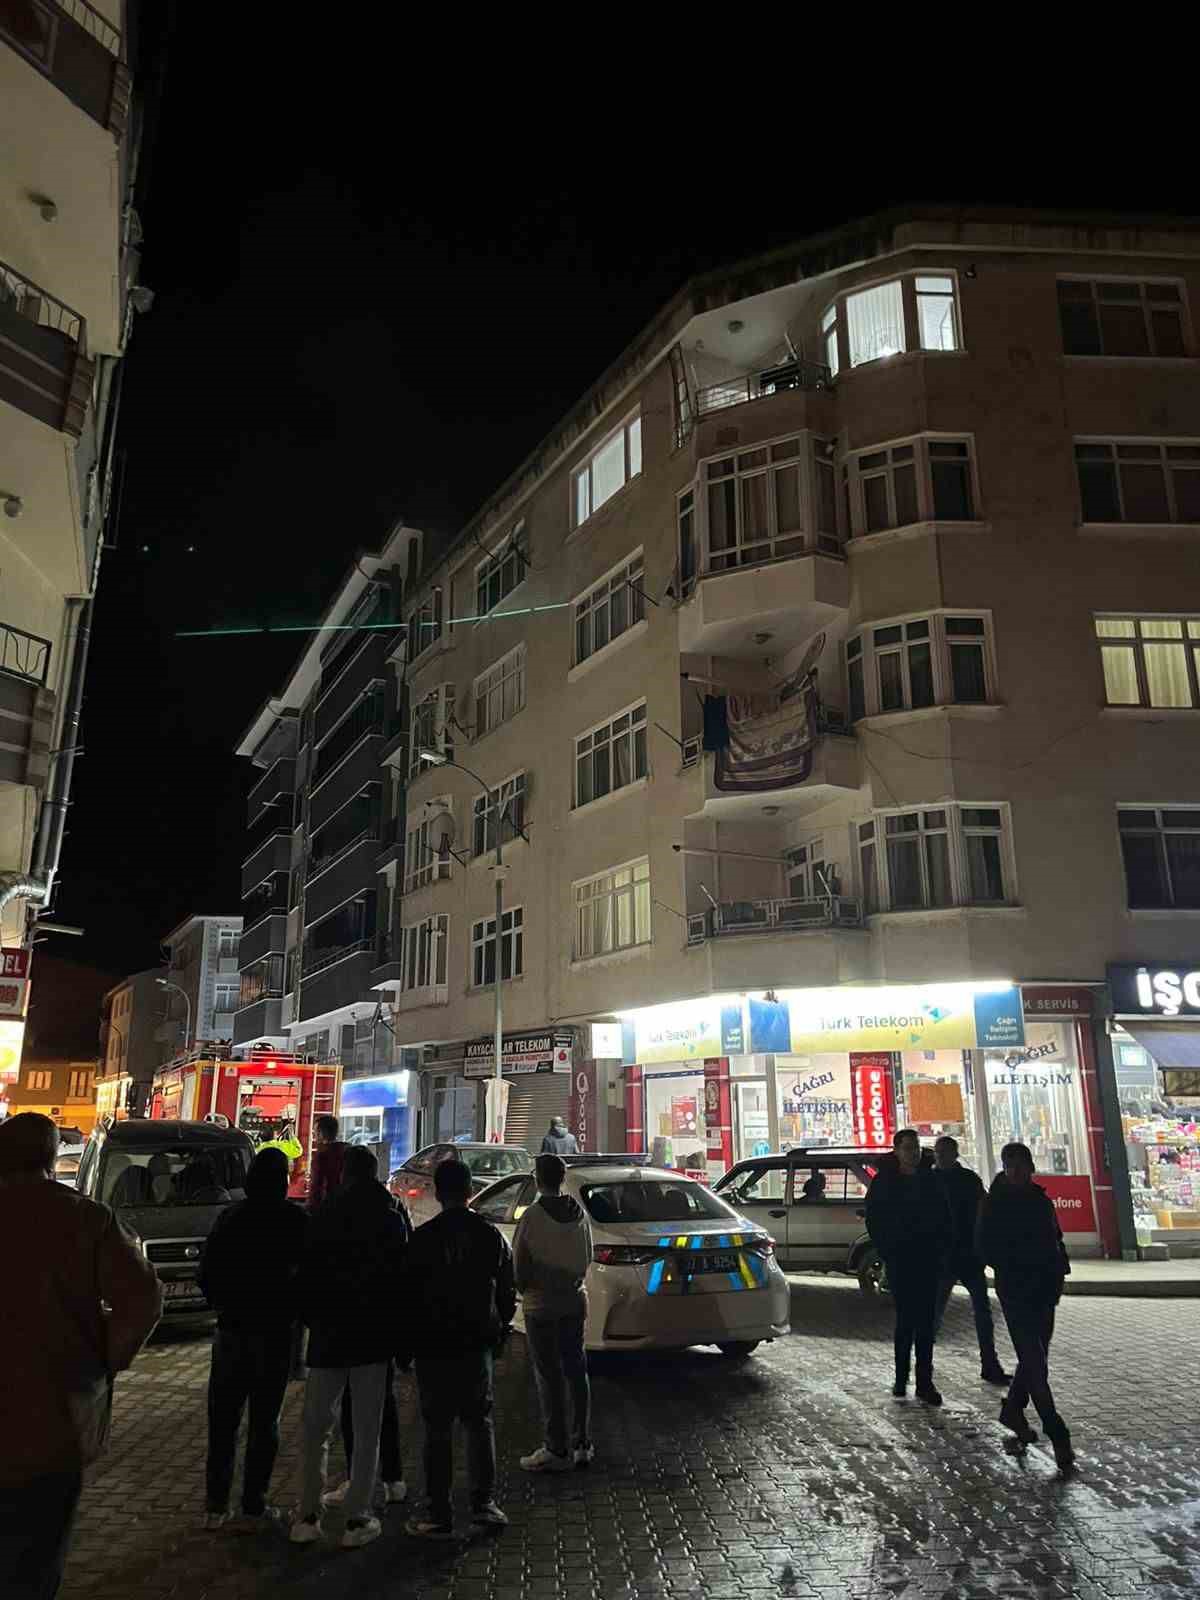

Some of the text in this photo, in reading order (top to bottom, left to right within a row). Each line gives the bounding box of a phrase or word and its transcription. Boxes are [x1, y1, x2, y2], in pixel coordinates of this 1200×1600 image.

[857, 1014, 925, 1030] Telekom
[467, 1040, 514, 1057] KAYACALAR
[515, 1038, 551, 1053] TELEKOM
[792, 1071, 835, 1097] ÇAĞRI
